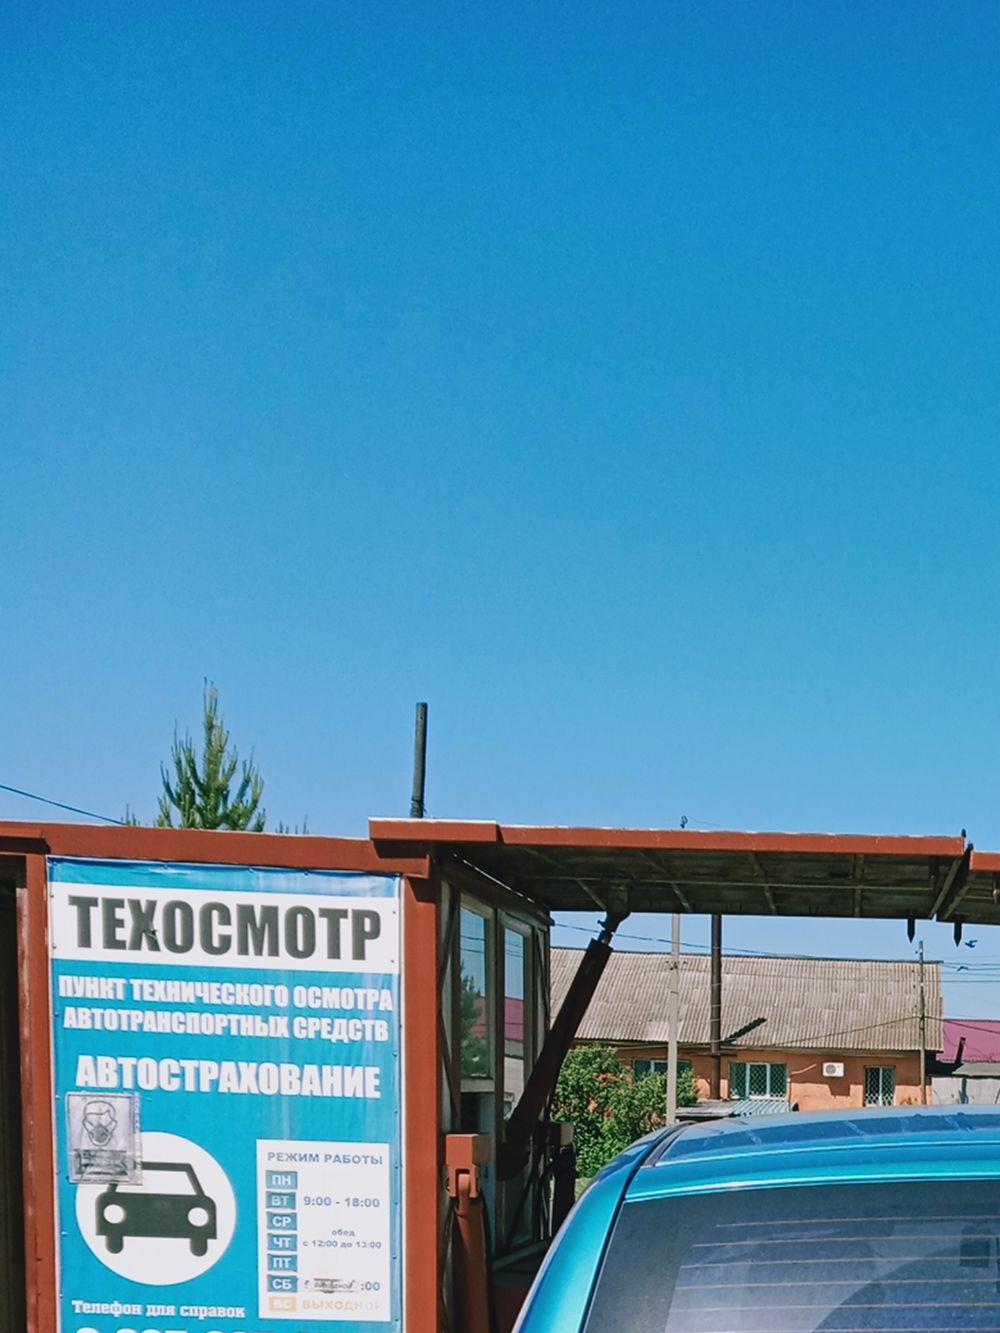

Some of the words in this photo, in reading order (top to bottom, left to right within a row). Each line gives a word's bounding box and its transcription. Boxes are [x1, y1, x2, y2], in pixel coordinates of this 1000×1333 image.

[67, 894, 382, 962] ТЕХОСМОТР
[58, 974, 127, 1001] ПУНКТ
[129, 977, 289, 1009] ТЕХНИЧЕСКОГО
[292, 985, 394, 1012] ОСМОТРА
[63, 1007, 291, 1039] АВТОТРАНСПОРТНЫХ
[292, 1017, 390, 1044] СРЕДСТВ
[75, 1054, 382, 1099] АВТОСТРАХОВАНИЕ
[266, 1151, 320, 1163] РЕЖИМ
[323, 1153, 384, 1166] РАБОТЫ
[271, 1174, 292, 1187] ПН
[270, 1195, 290, 1207] ВТ
[303, 1195, 332, 1207] 9:00
[344, 1197, 381, 1208] 18:00
[272, 1215, 292, 1228] СР
[331, 1229, 356, 1238] обед
[273, 1237, 292, 1249] ЧТ
[312, 1239, 338, 1248] 12:00
[272, 1257, 292, 1269] ПТ
[272, 1278, 293, 1290] СБ
[71, 1299, 143, 1318] Телефон
[145, 1303, 177, 1317] для
[179, 1304, 246, 1321] справок
